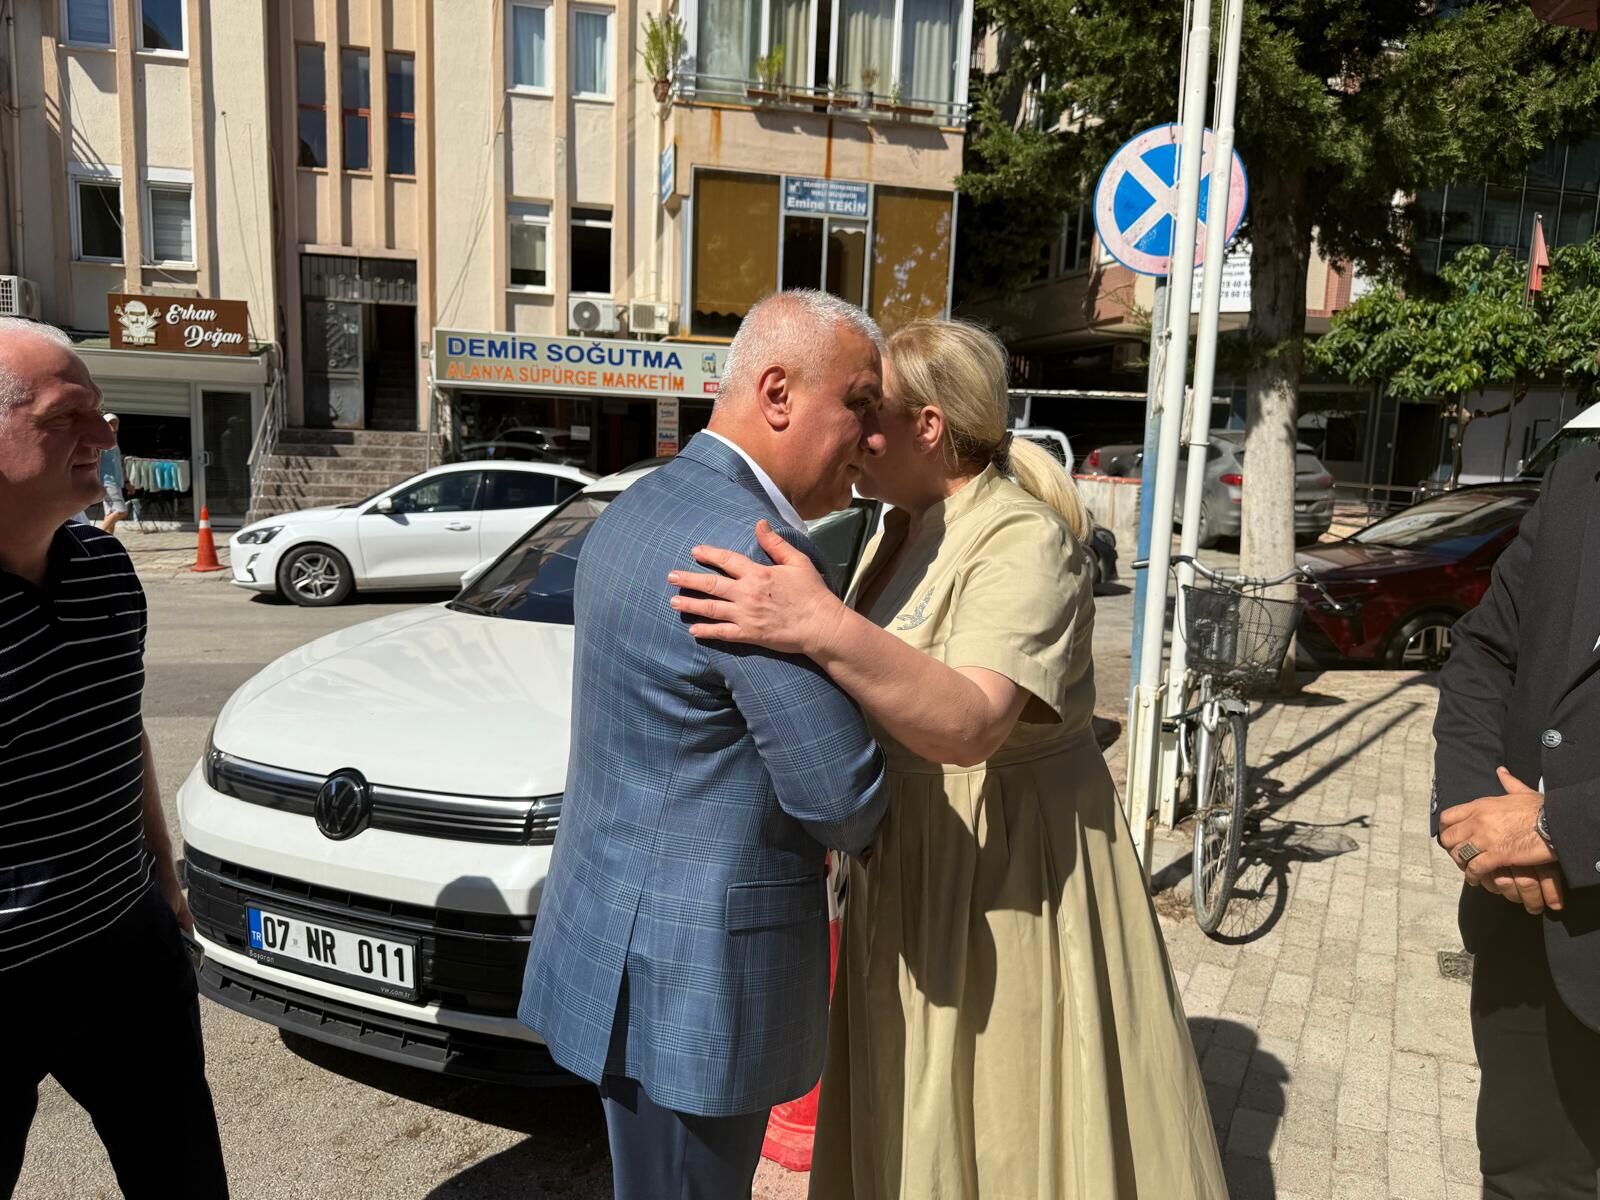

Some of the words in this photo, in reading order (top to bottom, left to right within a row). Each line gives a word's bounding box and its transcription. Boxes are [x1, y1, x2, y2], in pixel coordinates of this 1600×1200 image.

[787, 197, 825, 210] Emine
[828, 200, 867, 214] TEKİN
[165, 304, 217, 325] Erhan
[184, 325, 244, 348] Doğan
[447, 336, 538, 361] DEMİR
[546, 342, 683, 370] SOĞUTMA
[447, 362, 515, 381] ALANYA
[519, 366, 598, 386] SÜPÜRGE
[602, 371, 685, 391] MARKETİM
[251, 930, 262, 941] TR
[263, 916, 290, 951] 07
[306, 926, 337, 965] NR
[358, 939, 405, 982] 011
